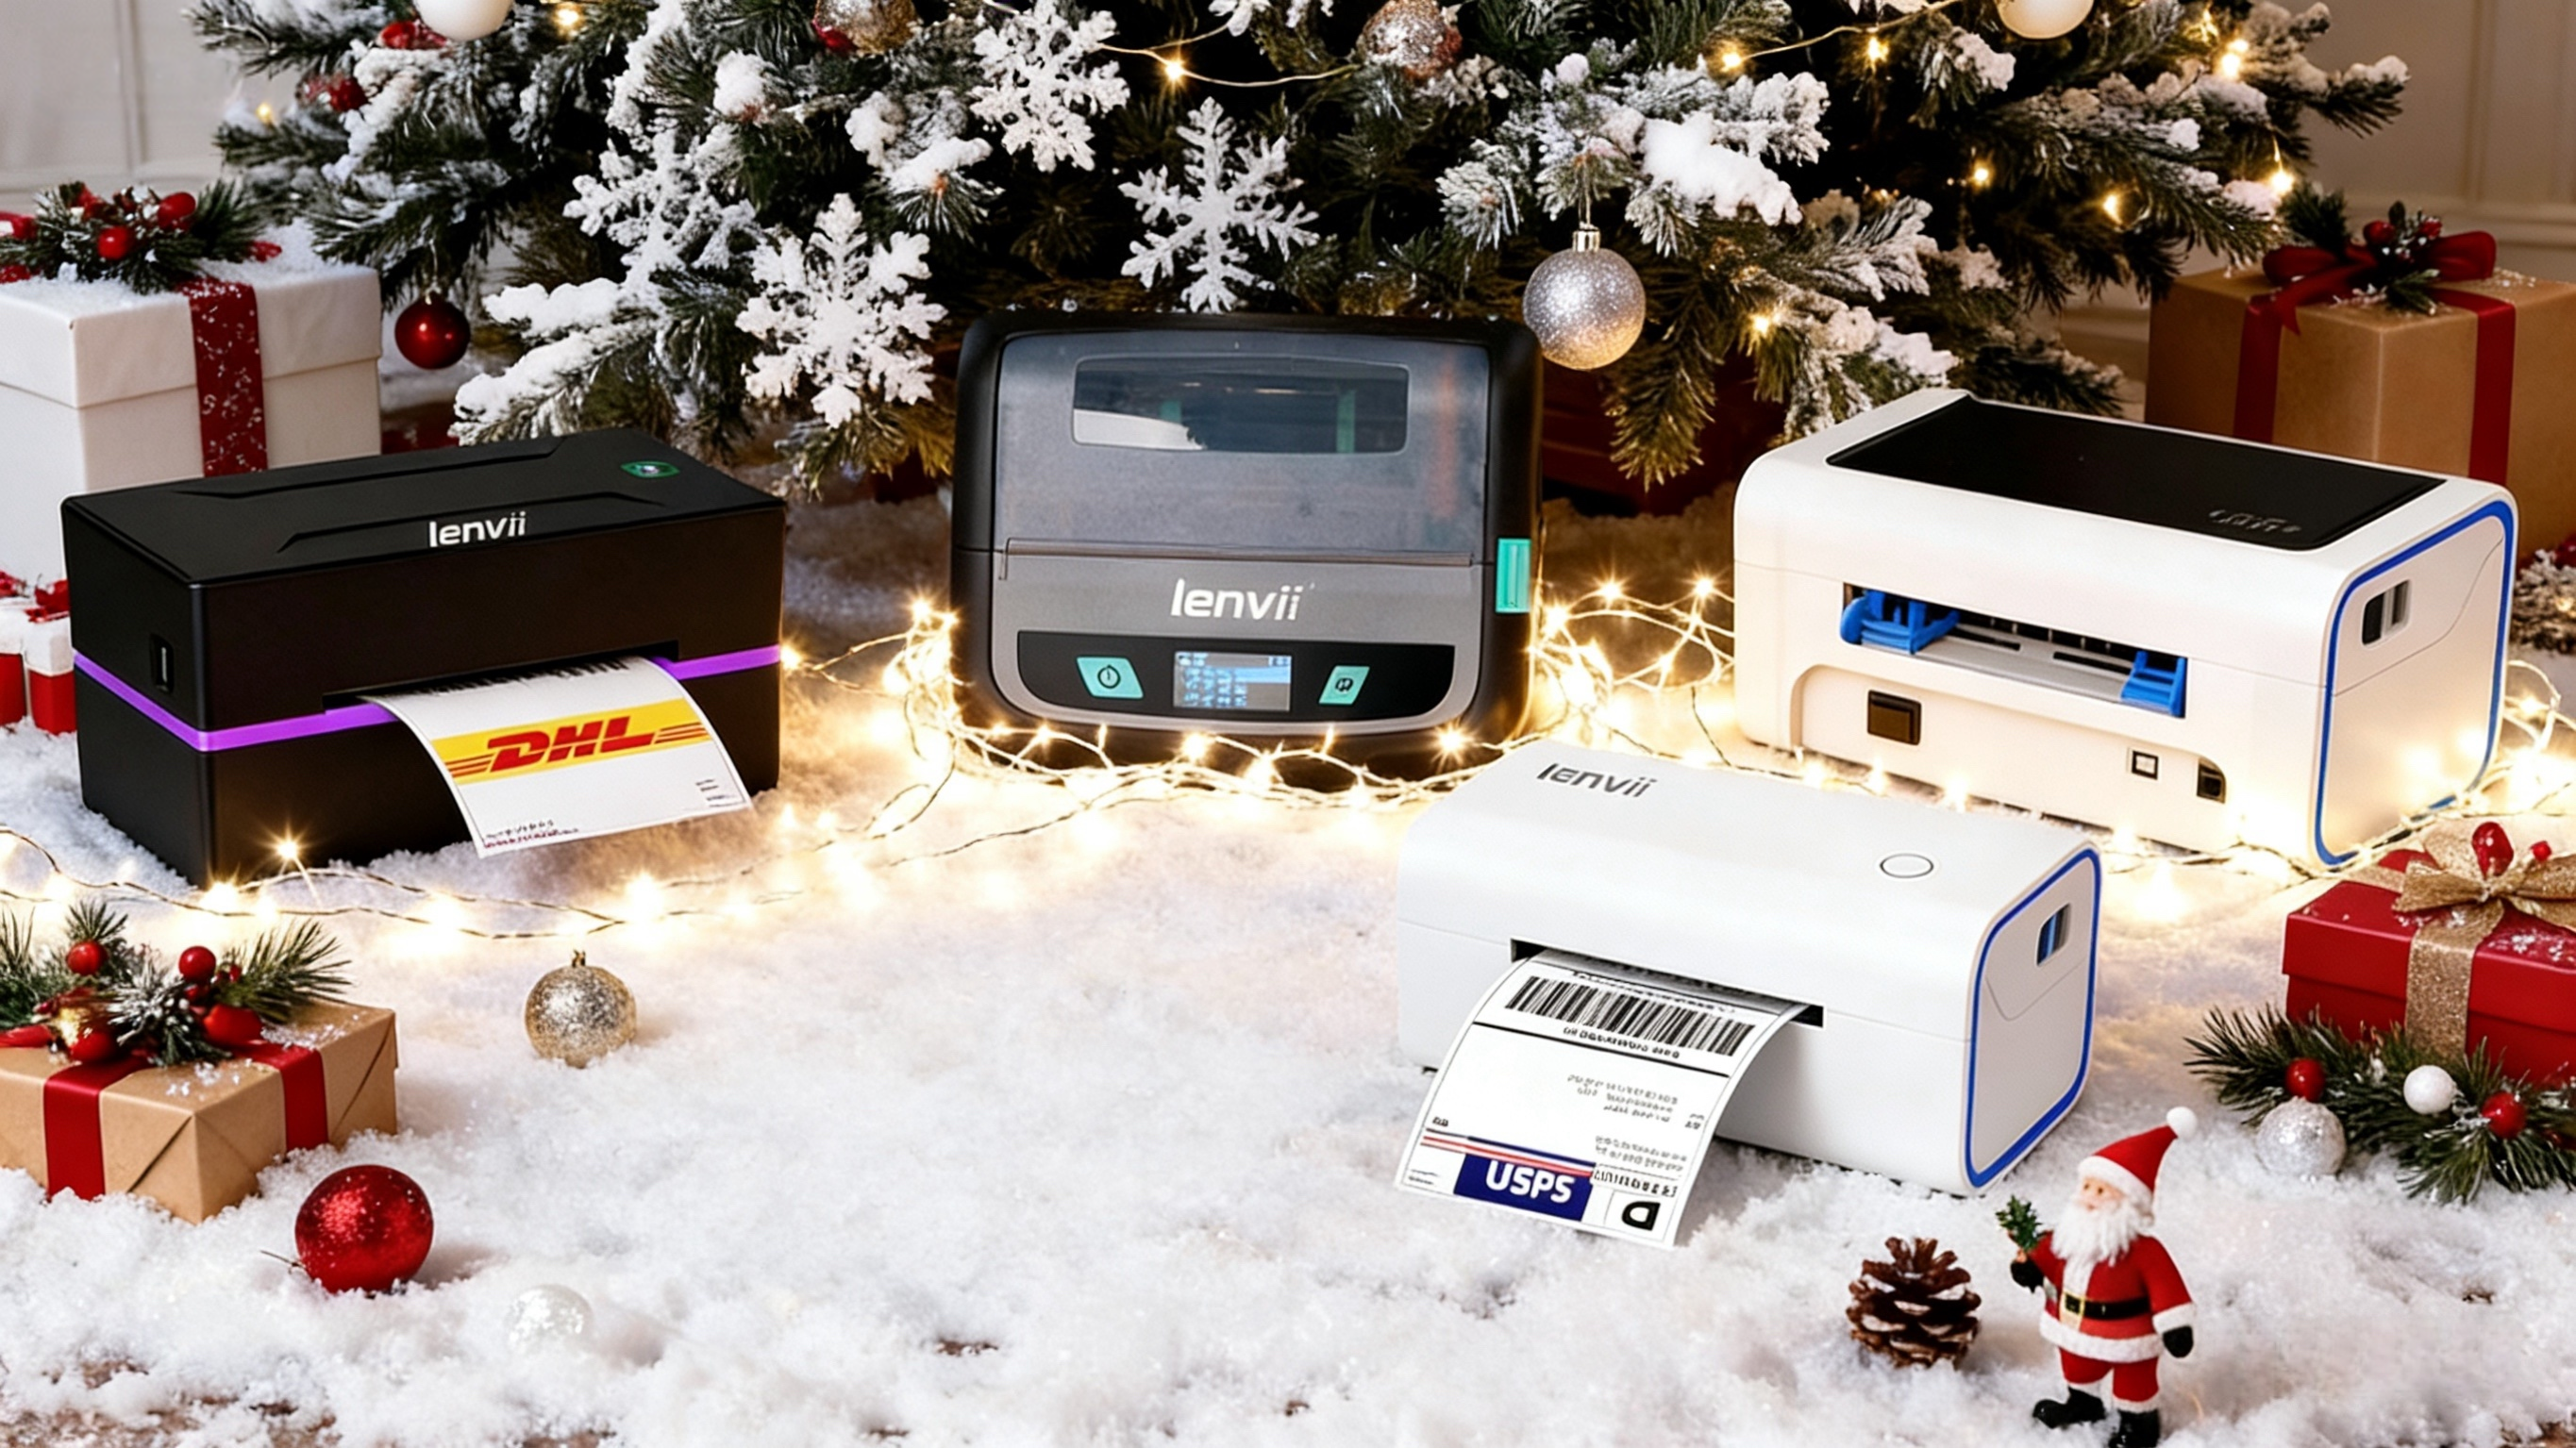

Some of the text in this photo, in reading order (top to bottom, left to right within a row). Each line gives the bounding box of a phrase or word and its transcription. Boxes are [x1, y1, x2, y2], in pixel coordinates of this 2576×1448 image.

[429, 510, 526, 547] lenvii
[1171, 578, 1303, 621] lenvii
[487, 716, 655, 773] DHL
[1536, 763, 1658, 797] lenvii
[1485, 1160, 1575, 1203] USPS
